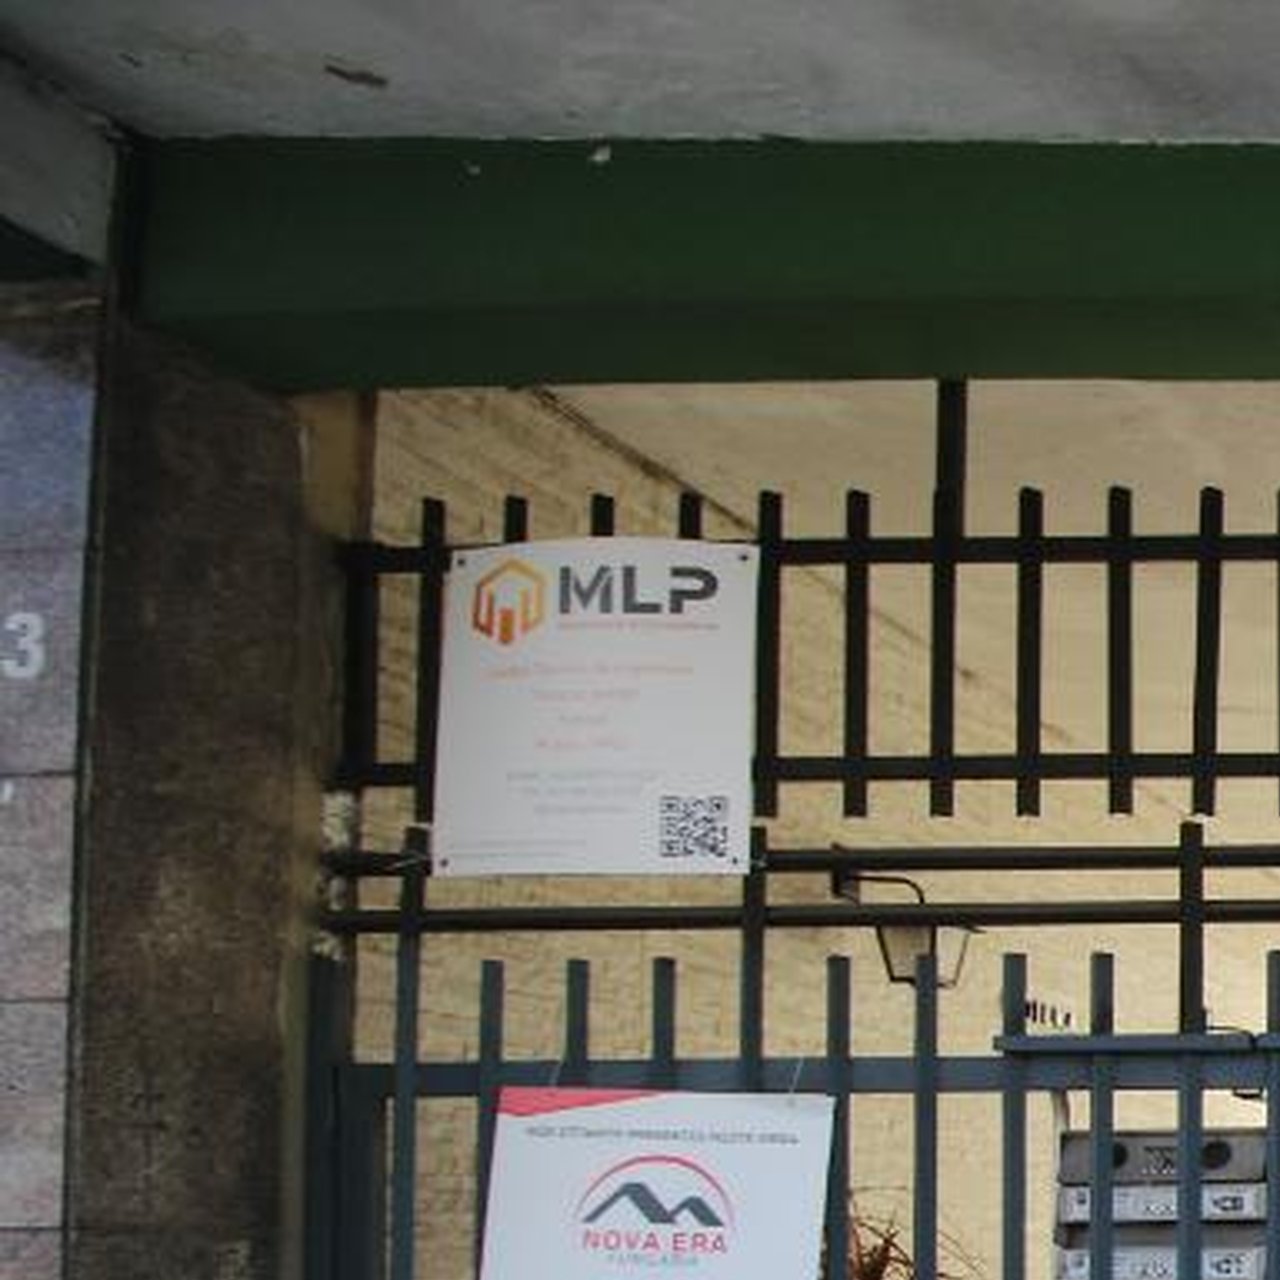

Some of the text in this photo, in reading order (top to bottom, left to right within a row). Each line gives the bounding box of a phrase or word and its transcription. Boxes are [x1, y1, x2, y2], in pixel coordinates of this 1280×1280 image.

[559, 566, 719, 614] MLP
[584, 1230, 727, 1253] NOVA ERA
